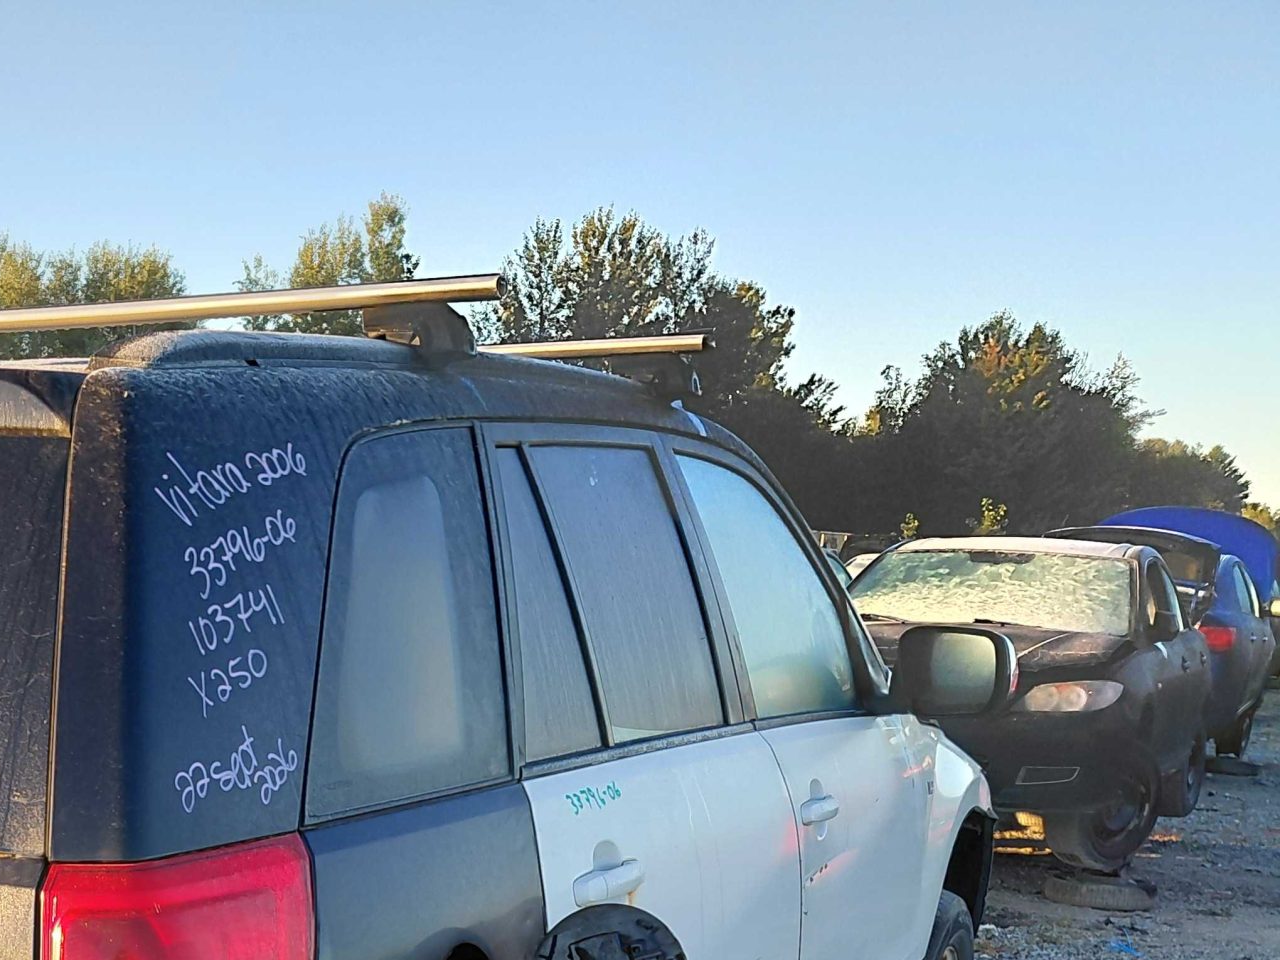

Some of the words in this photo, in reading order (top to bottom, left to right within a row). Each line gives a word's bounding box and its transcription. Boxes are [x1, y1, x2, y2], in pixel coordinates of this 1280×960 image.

[154, 451, 252, 527] Vitara
[244, 442, 308, 486] 2006
[184, 508, 297, 600] 33796-06
[189, 584, 285, 656] 103741
[187, 648, 268, 719] X250
